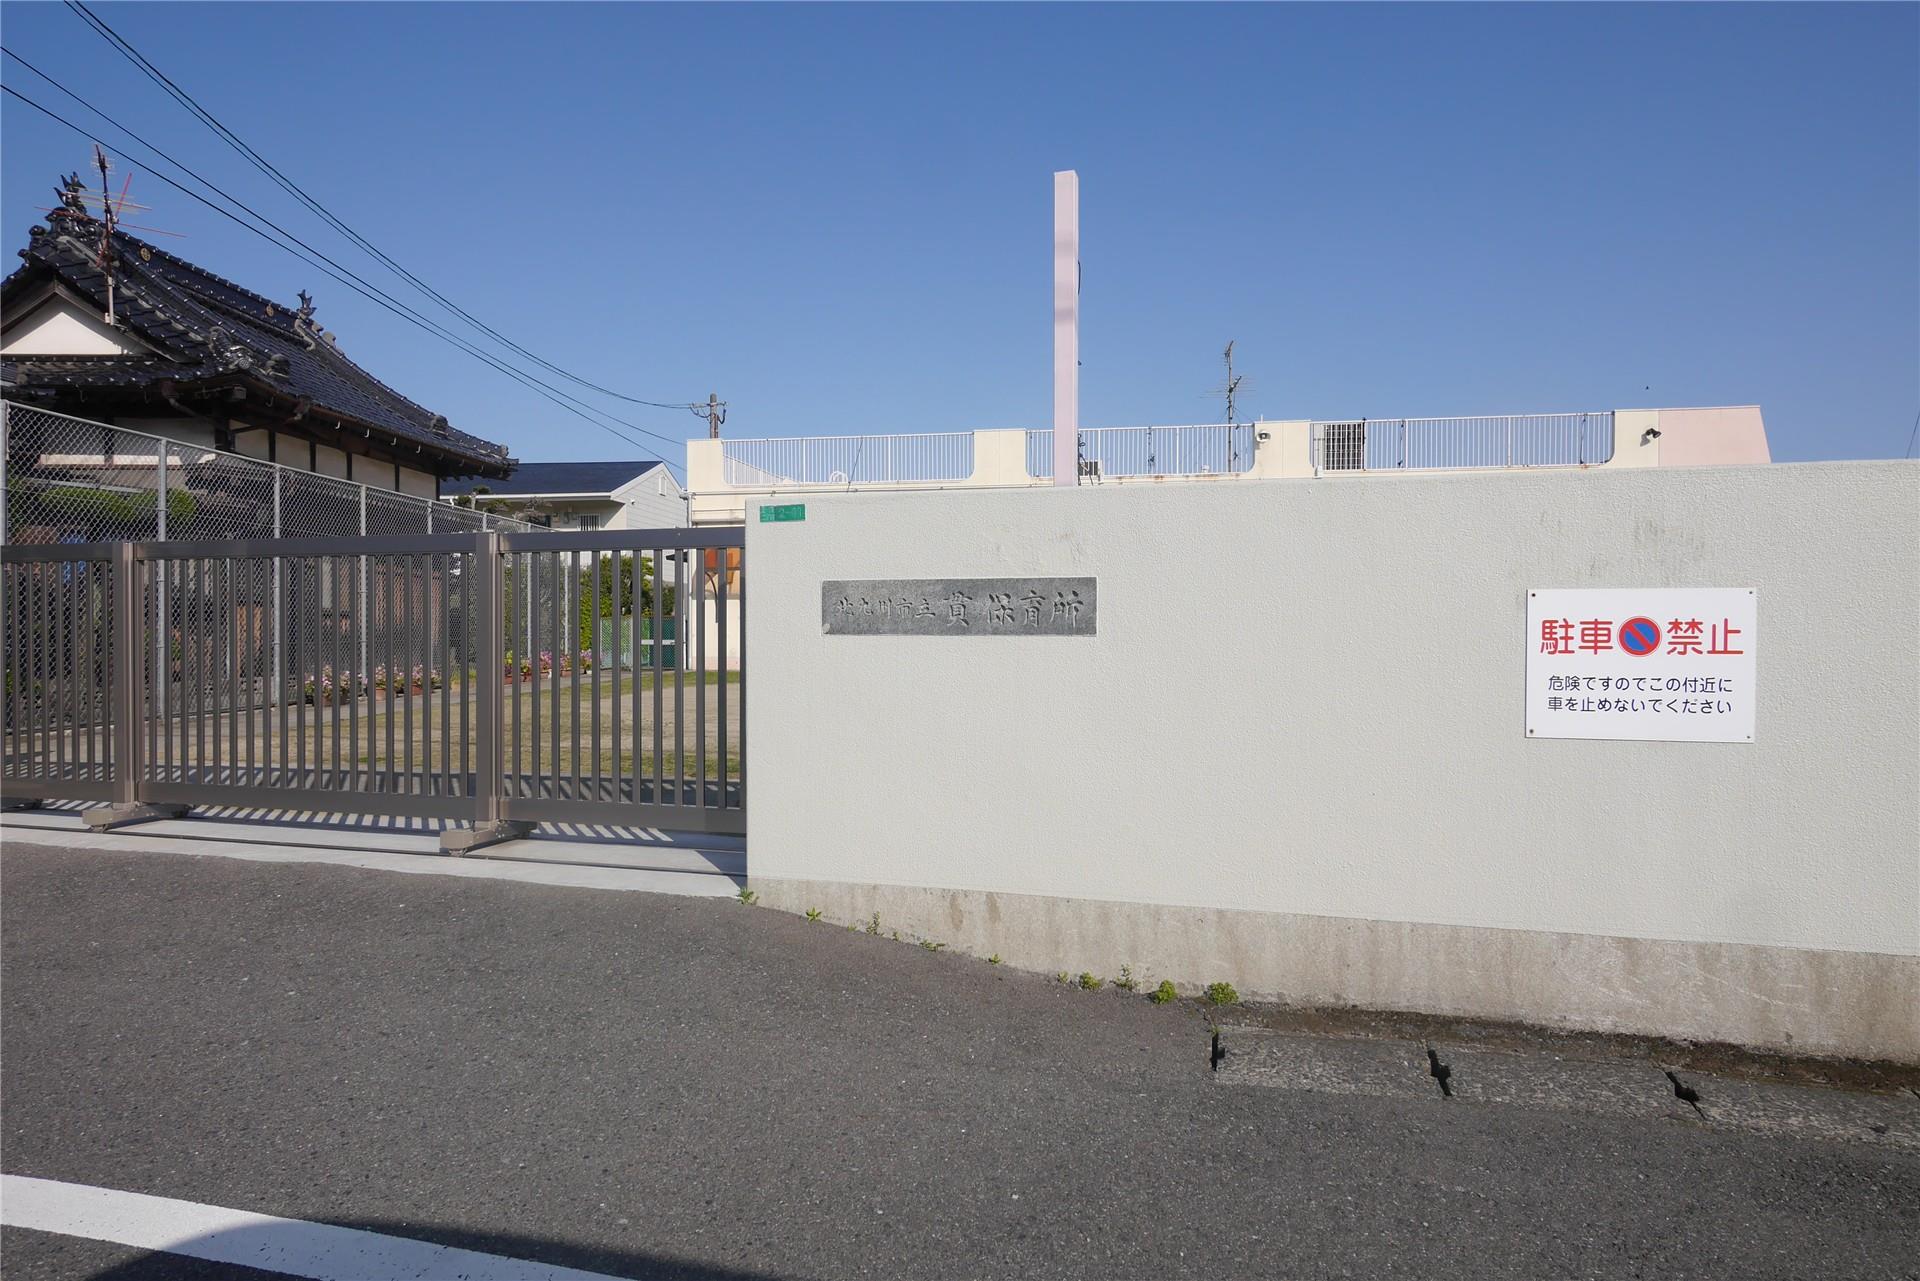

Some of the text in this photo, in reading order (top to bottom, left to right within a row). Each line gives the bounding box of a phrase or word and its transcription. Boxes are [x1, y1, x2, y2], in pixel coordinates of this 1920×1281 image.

[1540, 618, 1744, 655] 駐車 禁止
[1548, 675, 1733, 693] 危険ですのでこの付近に
[1548, 696, 1732, 714] 車を止めないでください
